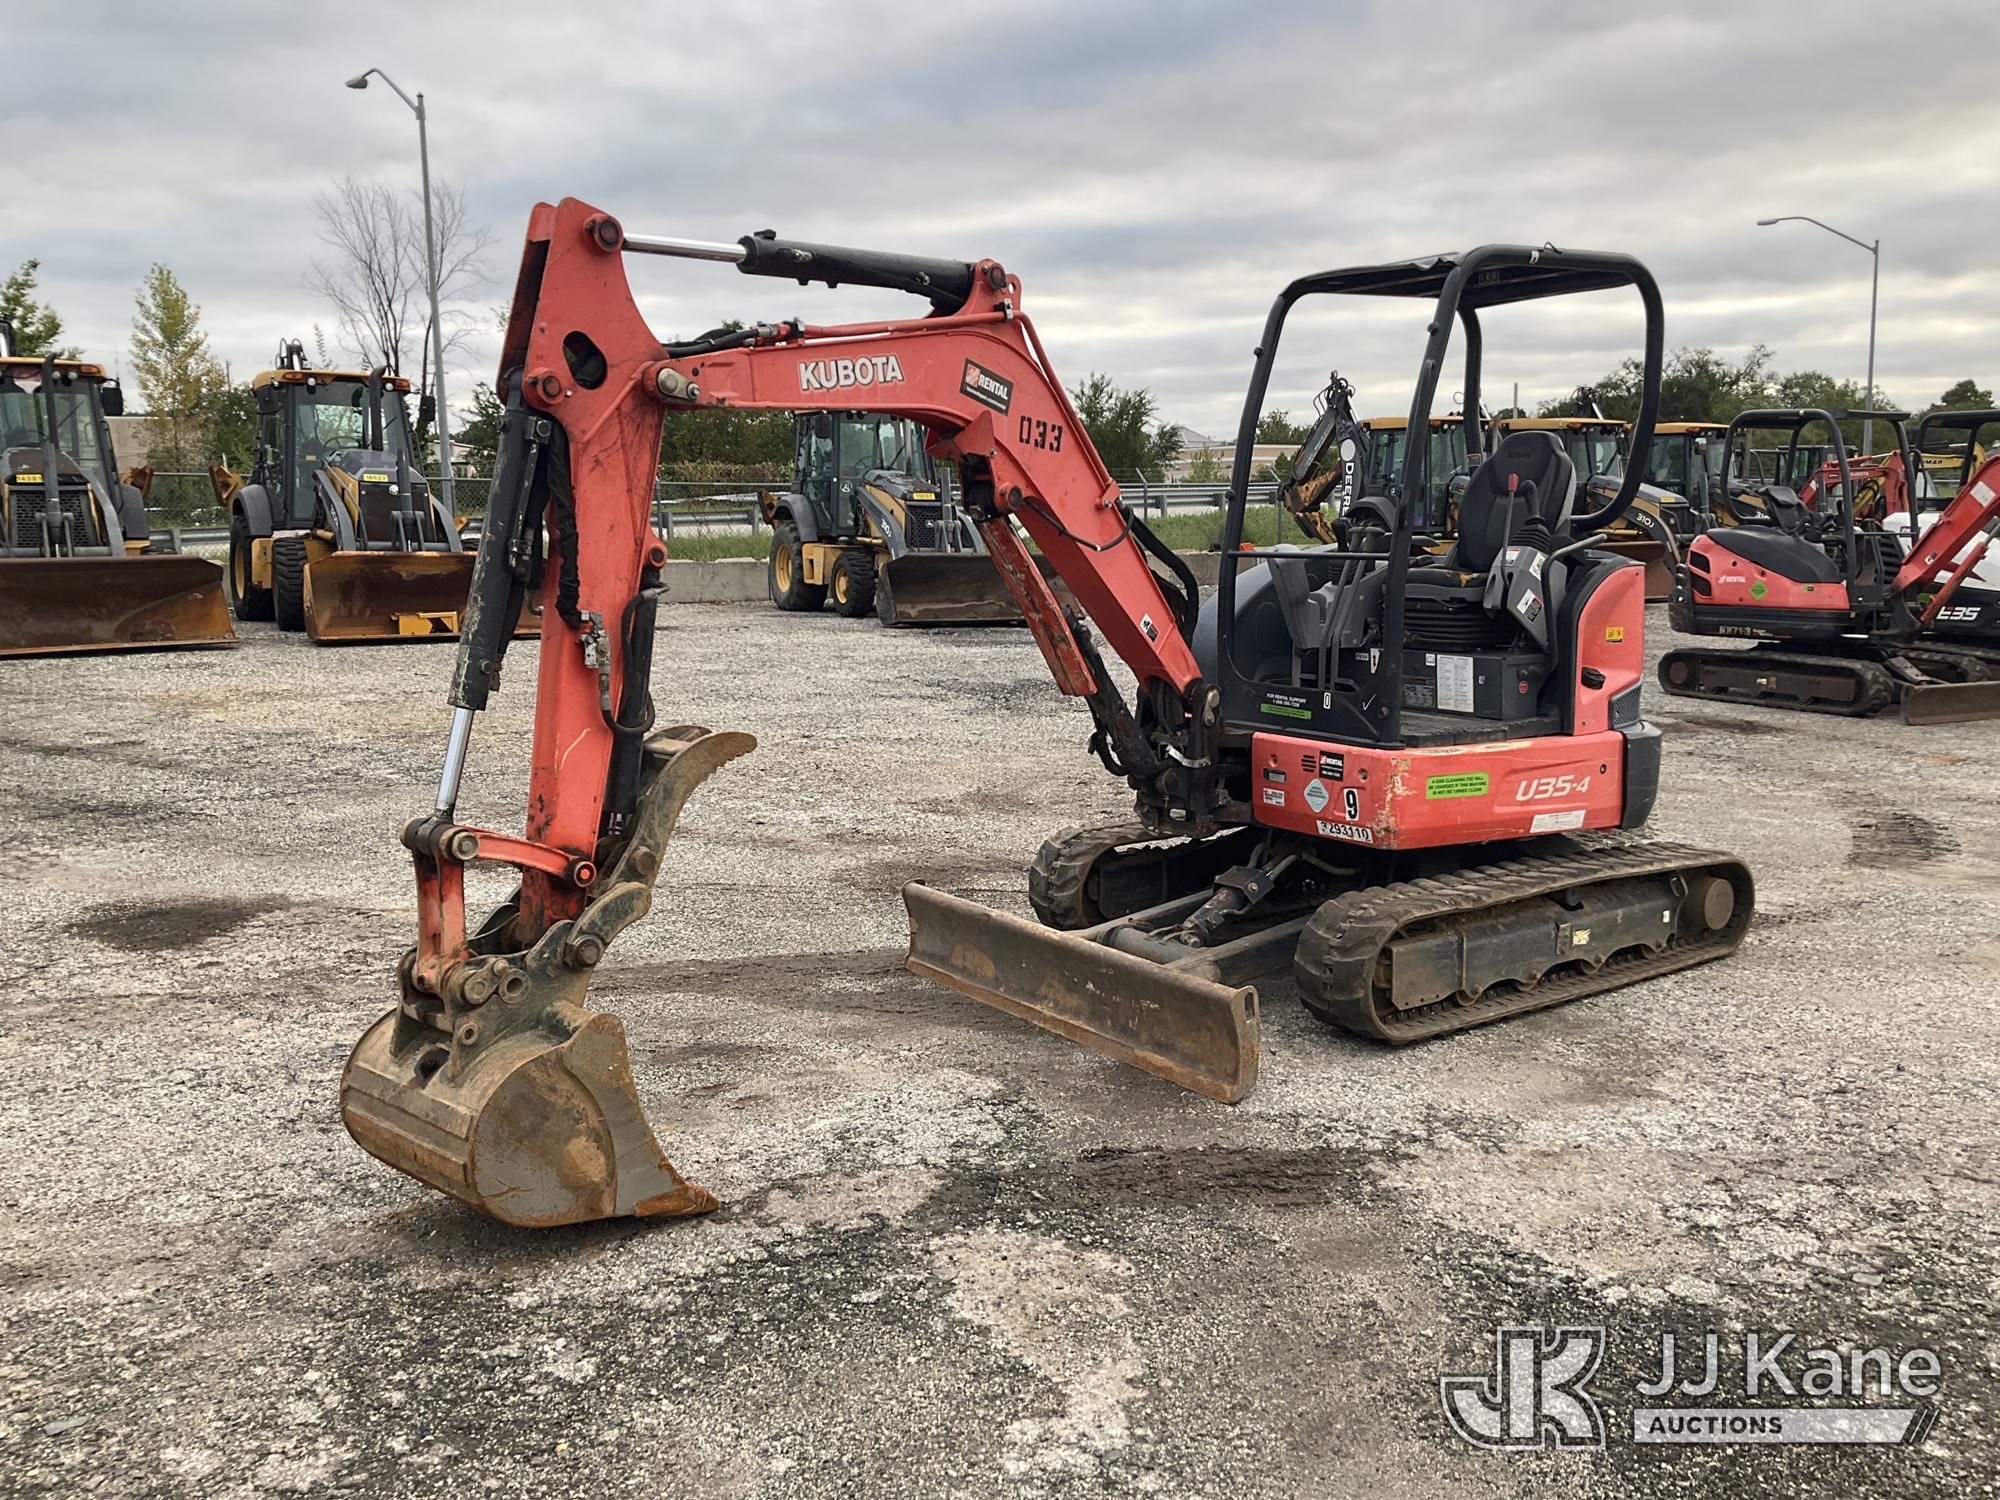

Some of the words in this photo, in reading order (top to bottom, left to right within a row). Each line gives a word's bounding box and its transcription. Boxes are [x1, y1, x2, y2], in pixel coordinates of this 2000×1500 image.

[799, 355, 905, 391] KUBOTA
[978, 374, 1009, 400] RENTAL
[1019, 415, 1064, 452] 033
[1636, 513, 1655, 528] 310J
[1936, 606, 1981, 621] E35
[1515, 774, 1591, 802] U35-4
[1345, 789, 1358, 820] 9
